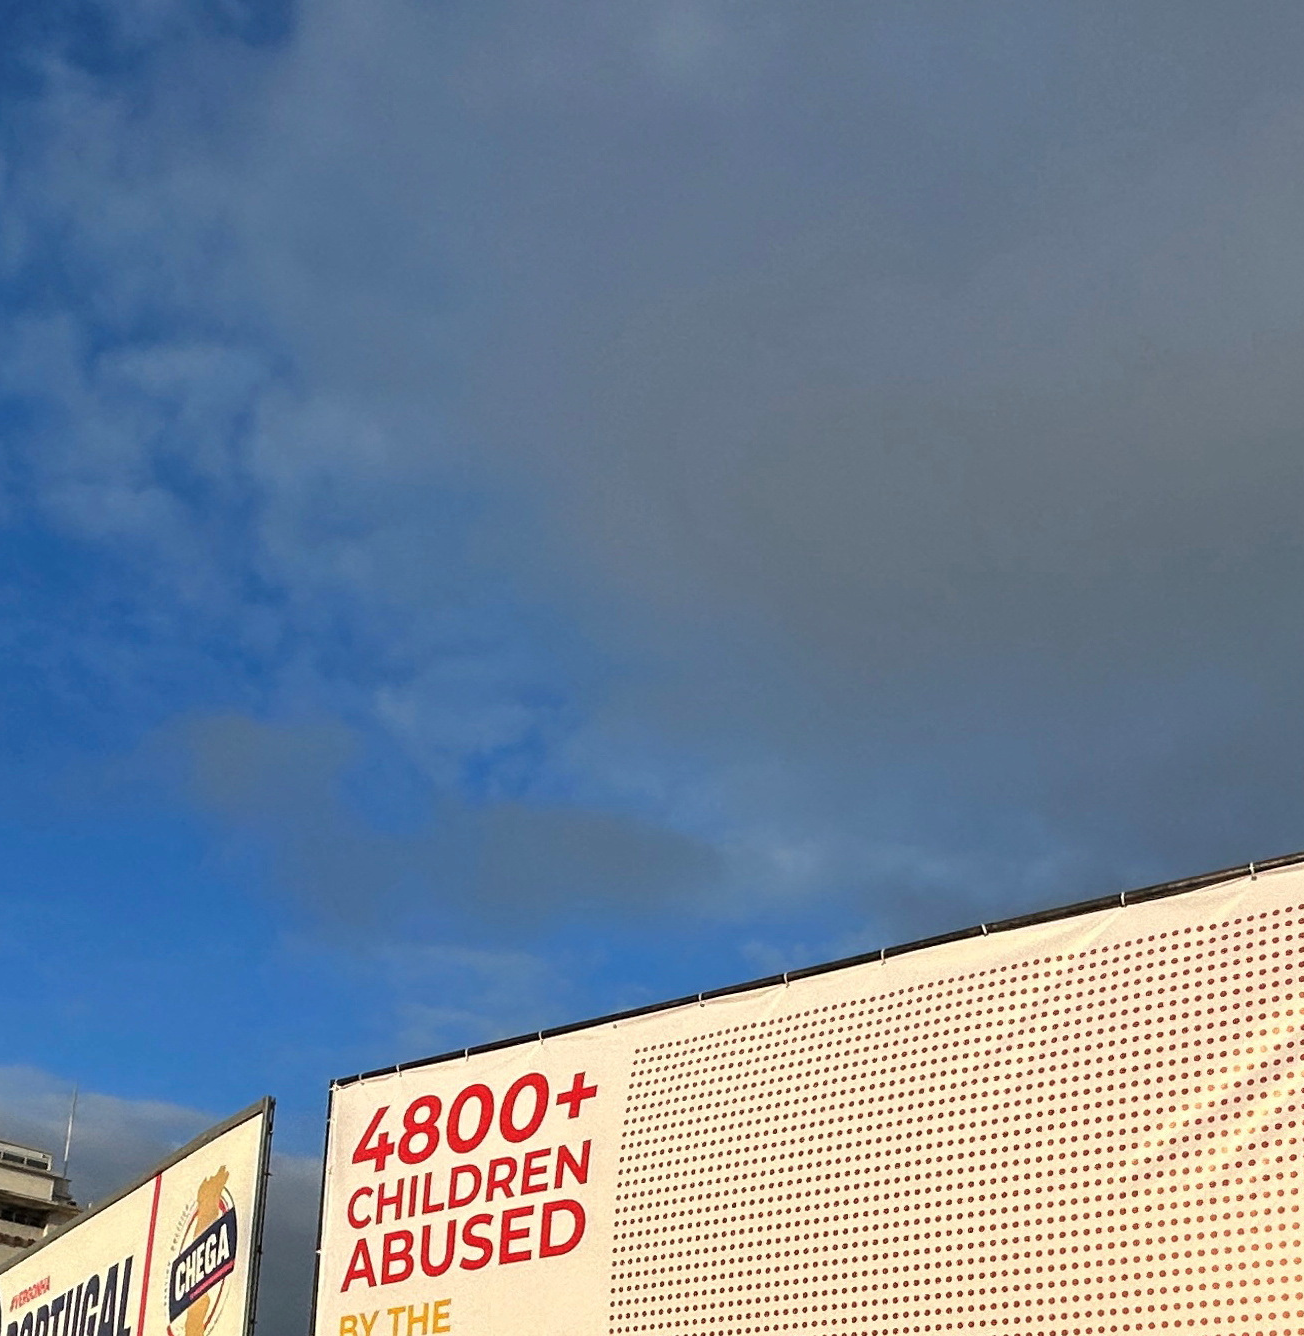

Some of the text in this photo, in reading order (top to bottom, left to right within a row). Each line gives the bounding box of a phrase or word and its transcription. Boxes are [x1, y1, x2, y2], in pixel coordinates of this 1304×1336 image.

[351, 1072, 598, 1172] 4800+
[347, 1139, 592, 1229] CHILDREN
[174, 1223, 230, 1301] CHEGA
[340, 1199, 586, 1293] ABUSED
